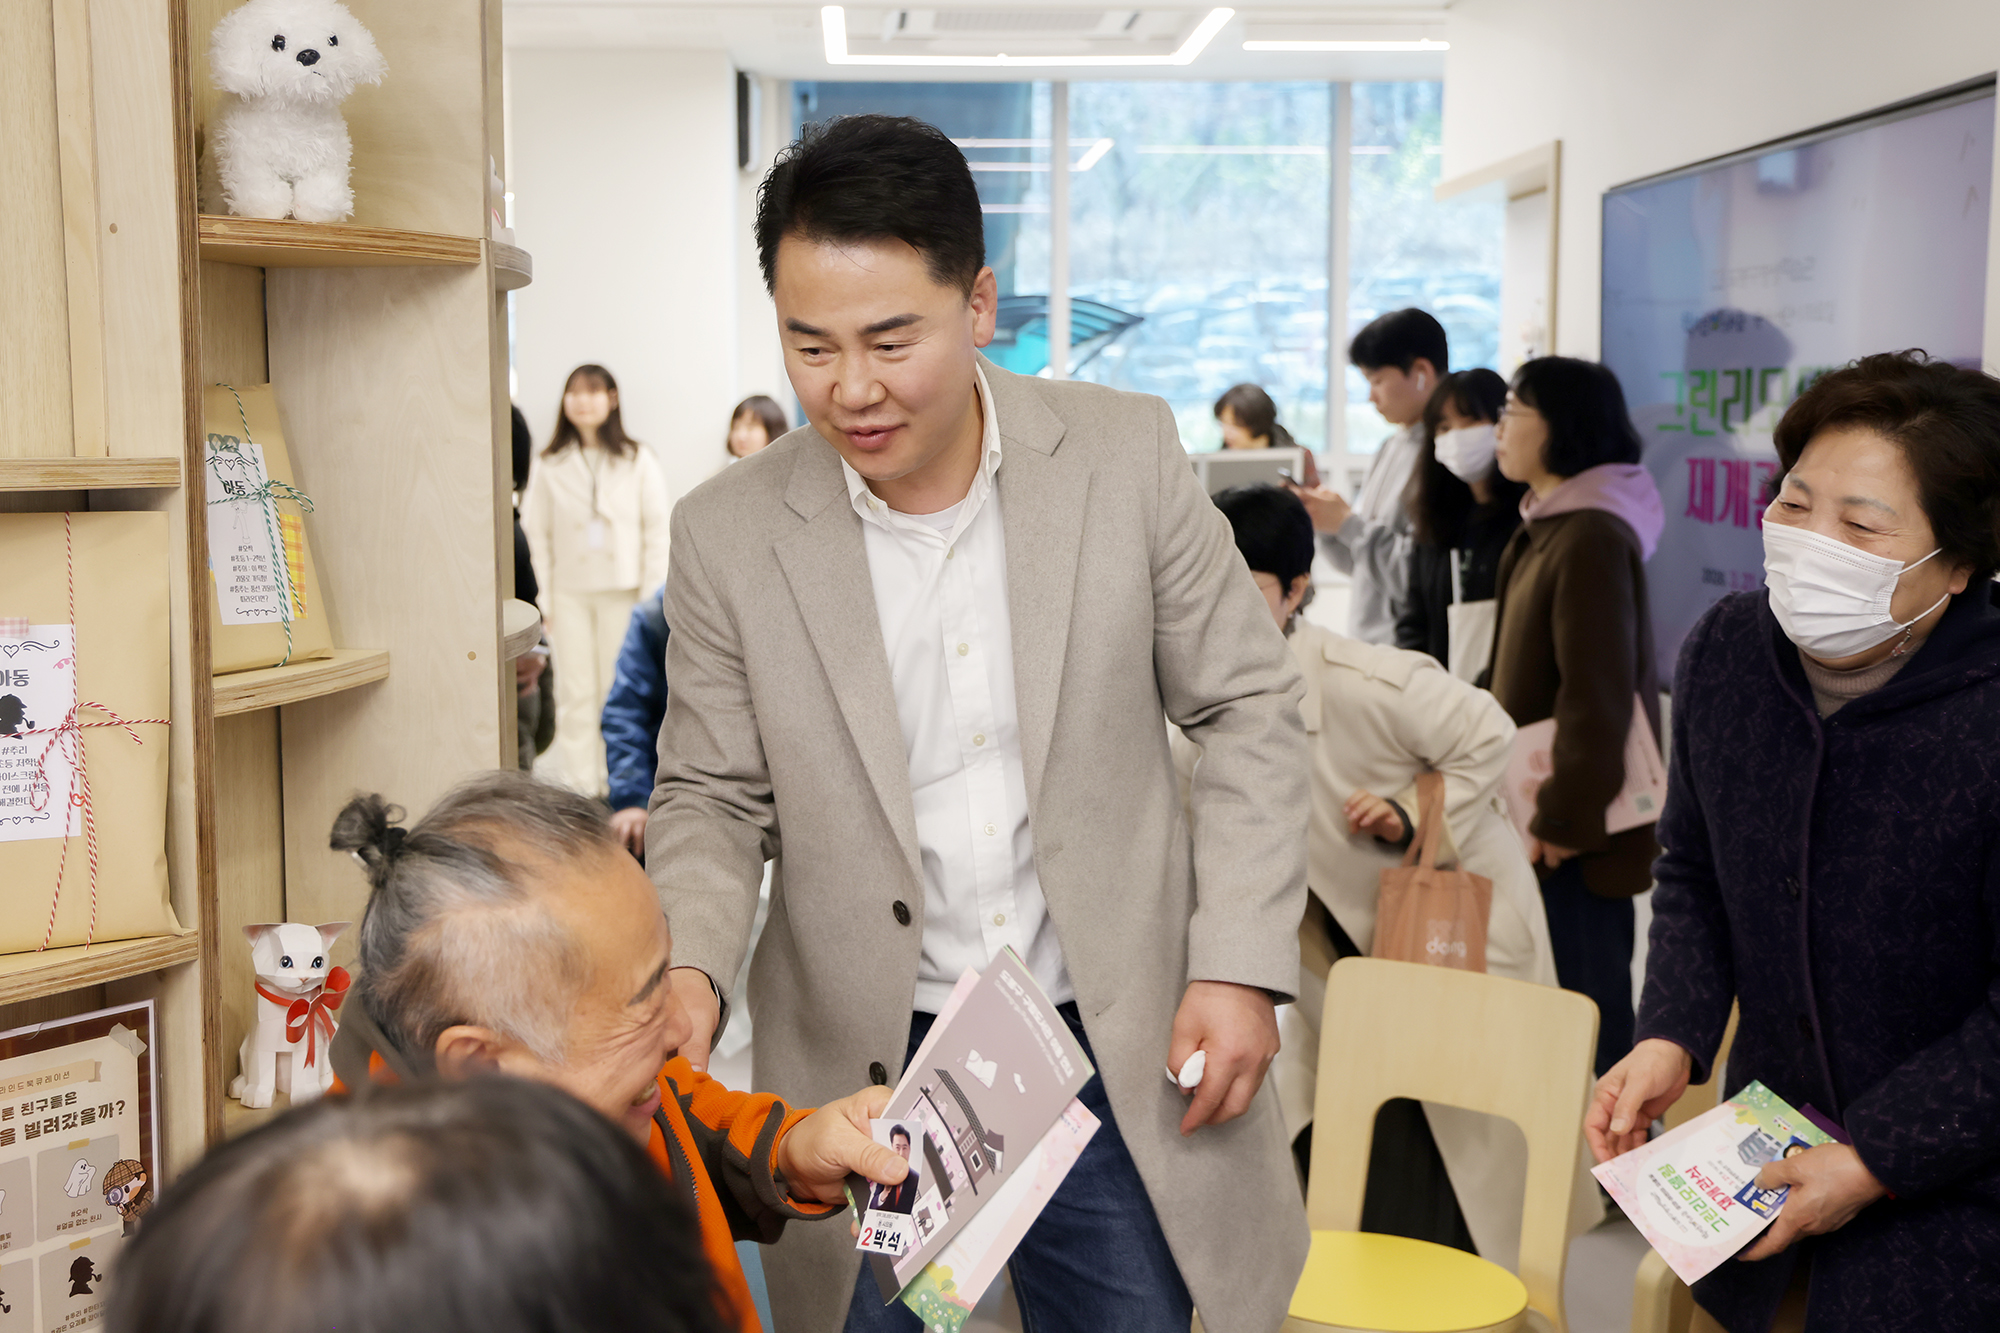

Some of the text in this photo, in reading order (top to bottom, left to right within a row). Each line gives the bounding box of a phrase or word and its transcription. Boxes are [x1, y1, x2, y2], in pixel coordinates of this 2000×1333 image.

[2, 745, 28, 755] #추리
[2, 785, 21, 795] 전에
[0, 1100, 126, 1147] 을 빌려갔을까?
[1657, 1163, 1729, 1233] 그린리모델링
[1685, 1165, 1737, 1211] 재개관식
[861, 1226, 873, 1246] 2
